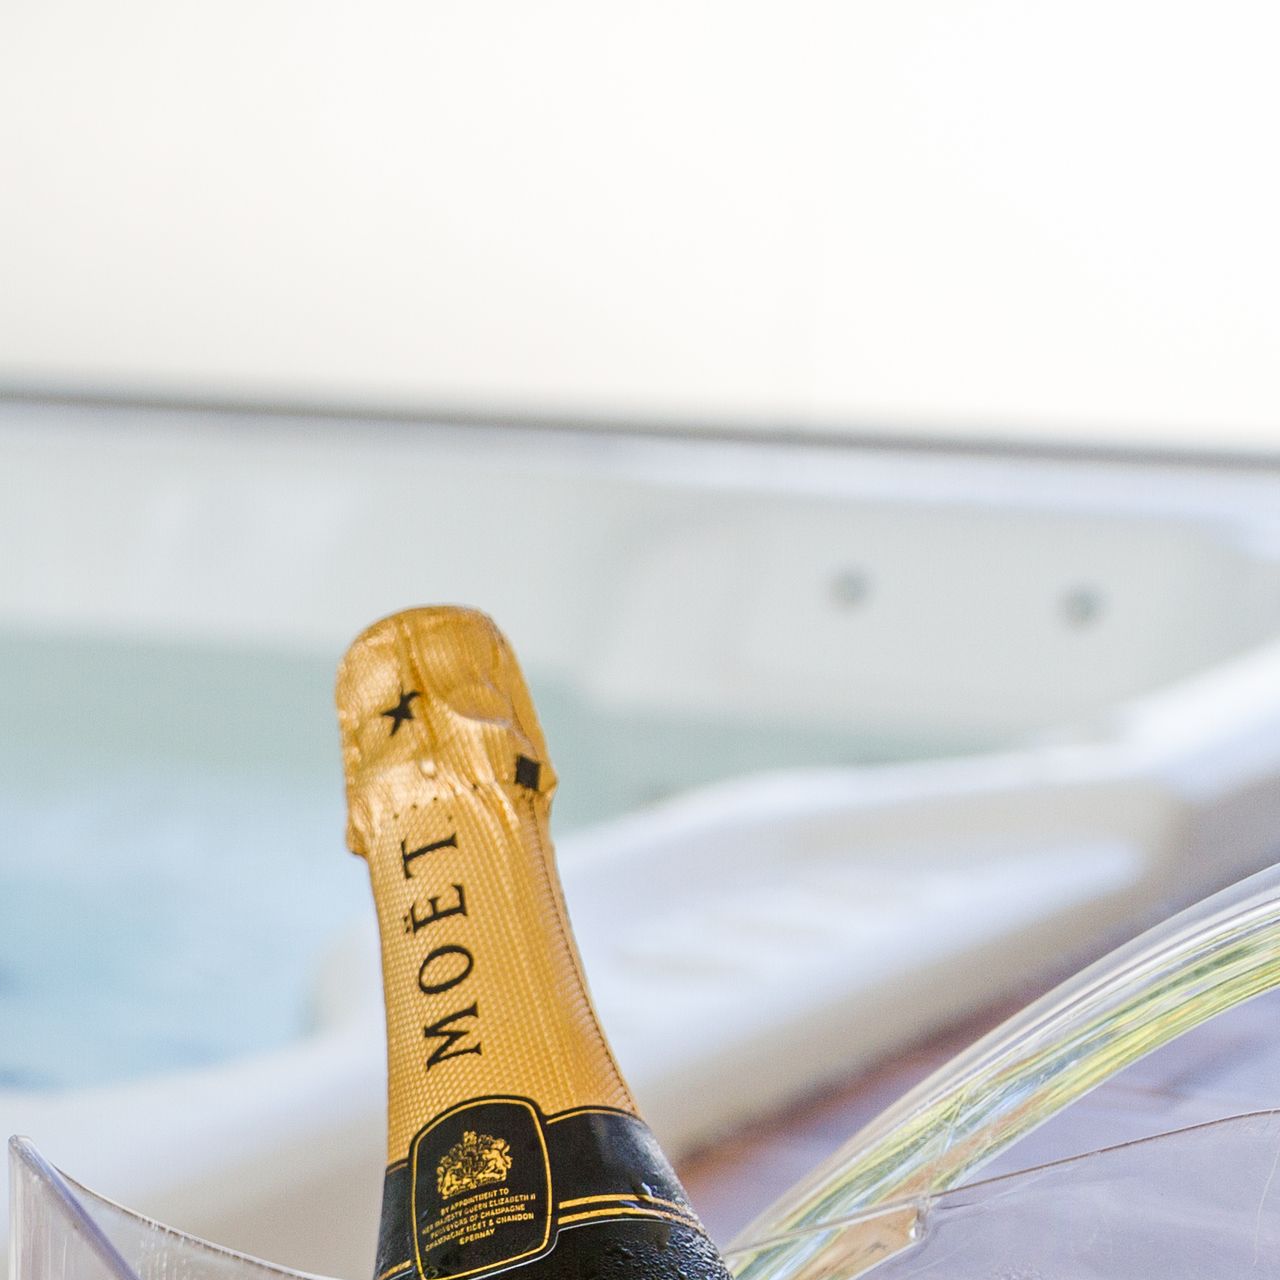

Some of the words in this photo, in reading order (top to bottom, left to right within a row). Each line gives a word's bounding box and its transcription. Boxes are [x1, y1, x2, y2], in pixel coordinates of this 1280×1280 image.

[401, 833, 483, 1072] MOËT
[499, 1187, 509, 1195] TO
[489, 1194, 529, 1207] ELIZABETH
[480, 1203, 526, 1219] CHAMPAGNE
[496, 1212, 535, 1224] CHANDON
